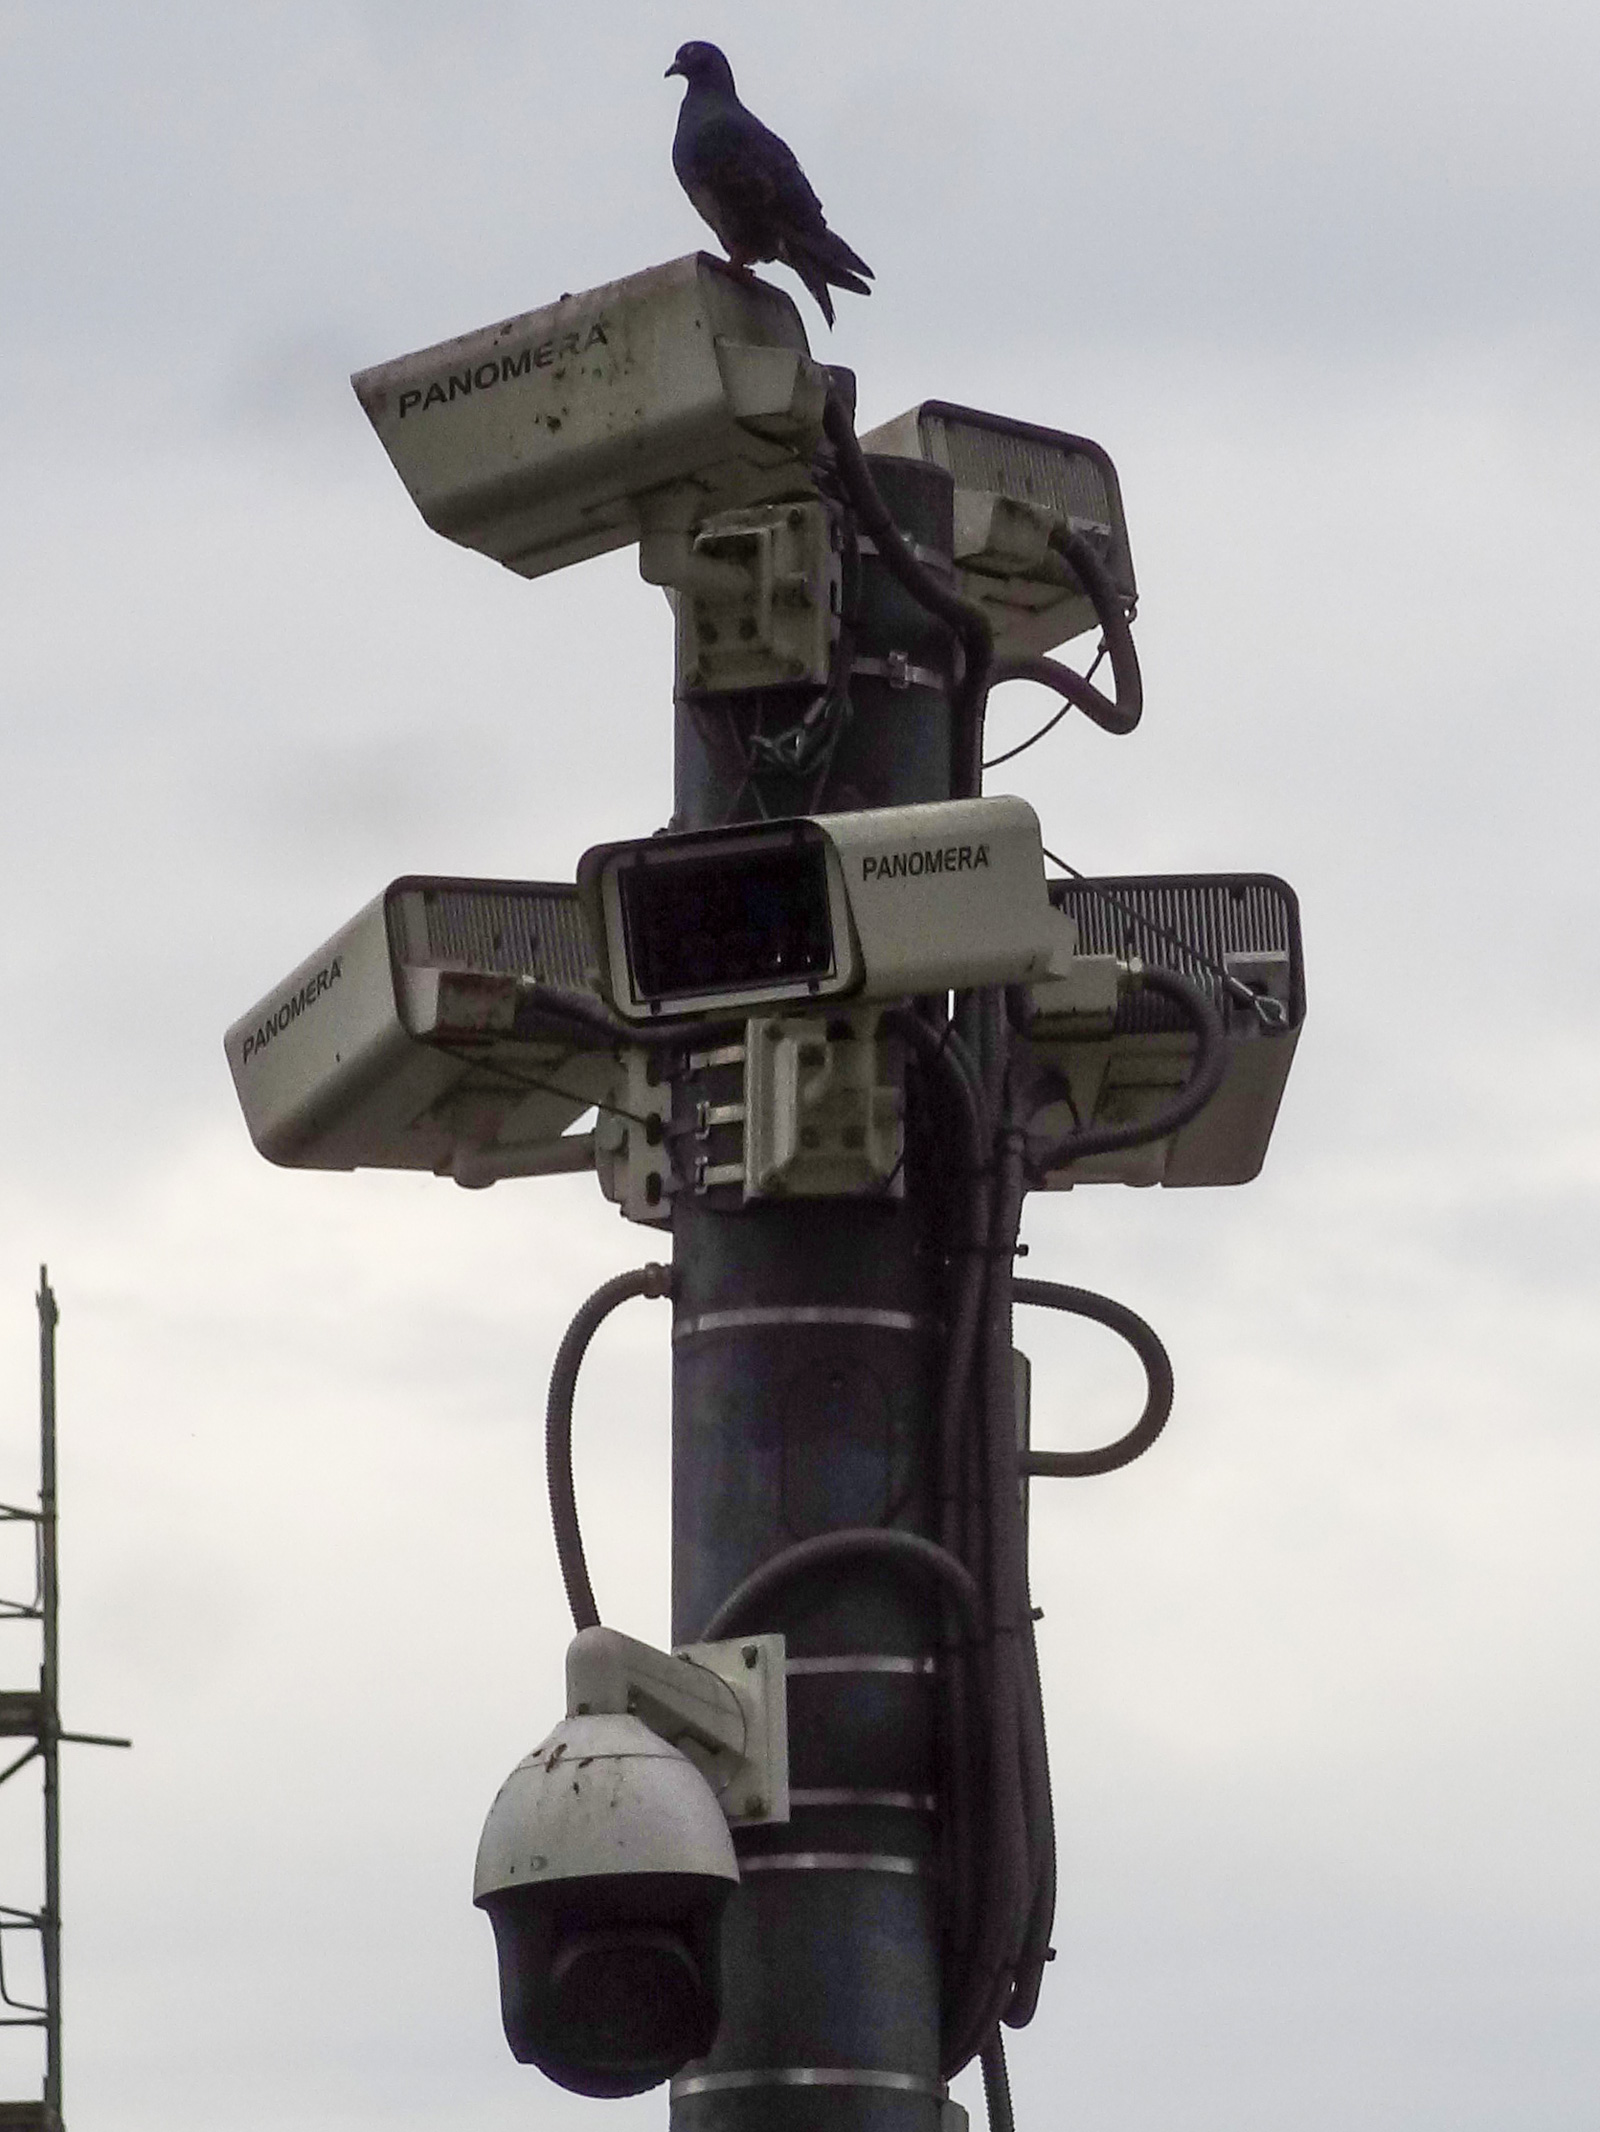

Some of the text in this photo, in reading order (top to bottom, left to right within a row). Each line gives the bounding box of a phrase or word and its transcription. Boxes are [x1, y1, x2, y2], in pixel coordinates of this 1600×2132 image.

[400, 322, 609, 418] PANOMERA
[862, 845, 989, 882] PANOMERA
[243, 957, 342, 1064] PANOMERA
